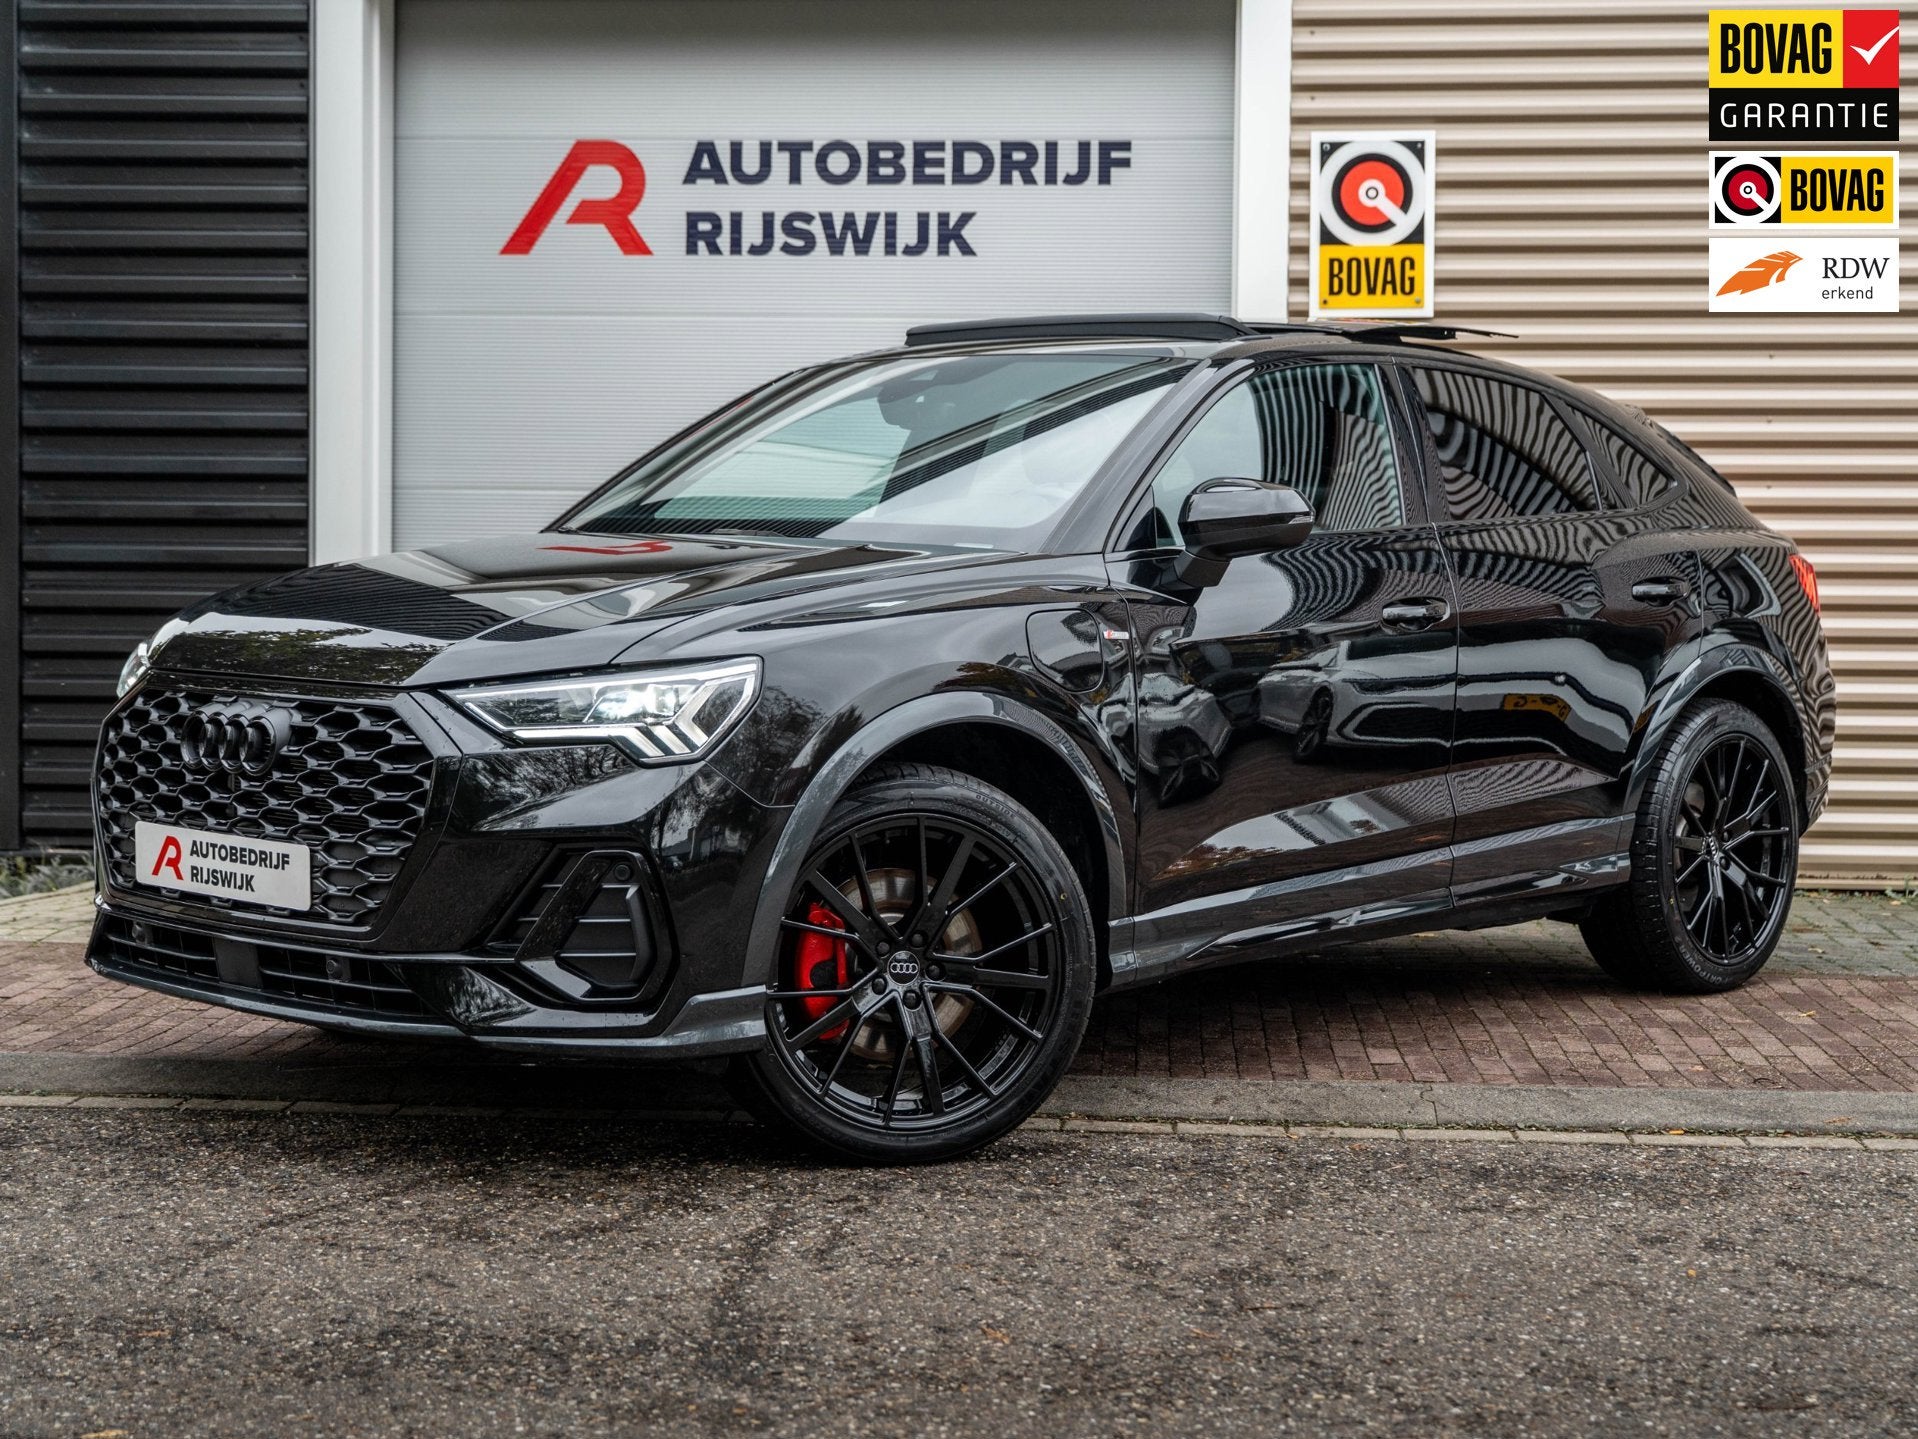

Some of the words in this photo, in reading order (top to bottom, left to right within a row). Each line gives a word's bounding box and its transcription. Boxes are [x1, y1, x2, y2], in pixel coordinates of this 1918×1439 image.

[682, 139, 1132, 186] AUTOBEDRIJF
[685, 211, 977, 257] RIJSWIJK
[1328, 256, 1416, 296] BOVAG
[189, 840, 290, 871] AUTOBEDRIJF
[190, 866, 256, 892] RIJSWIJK
